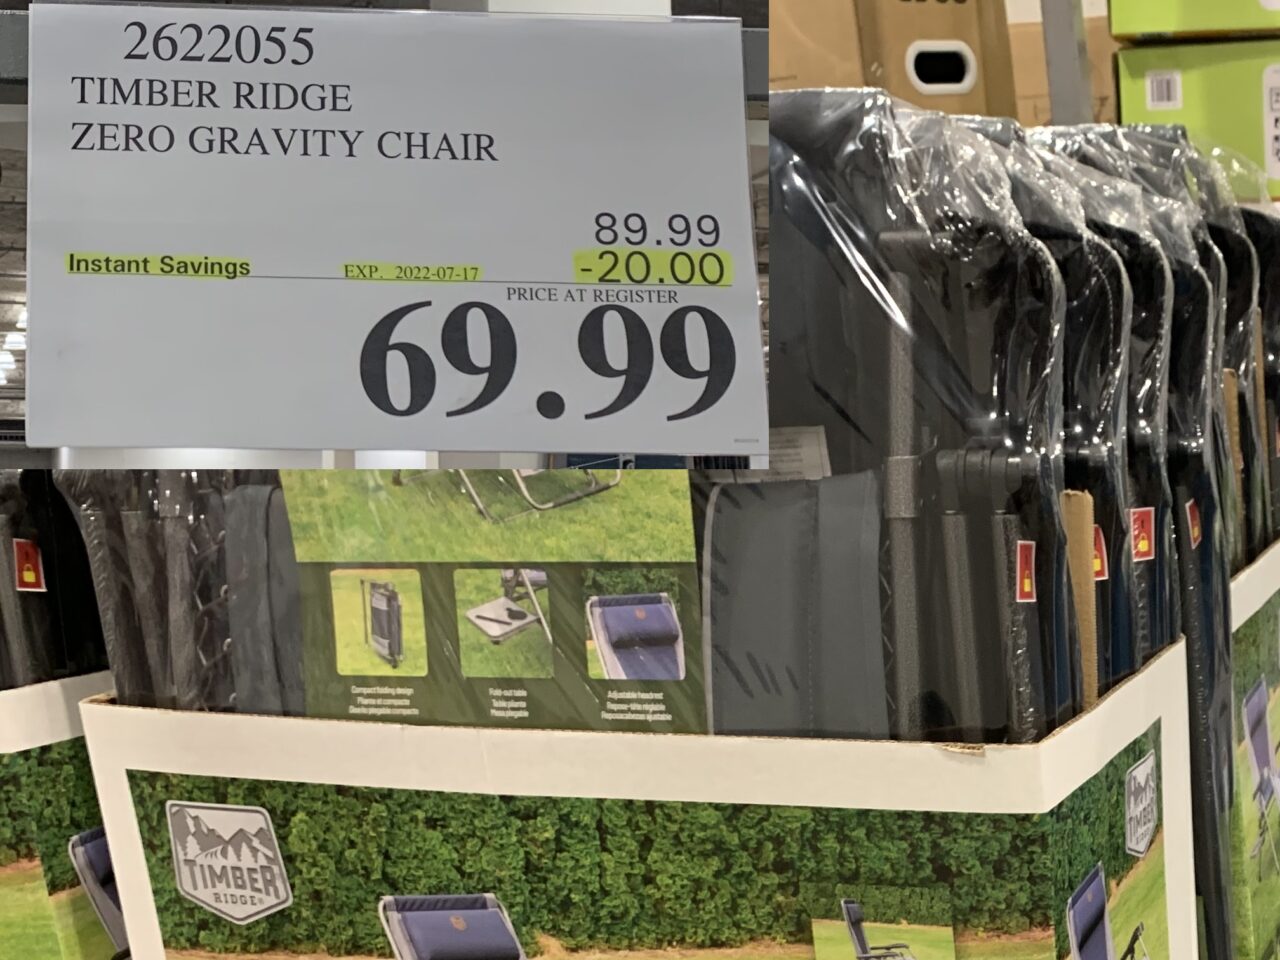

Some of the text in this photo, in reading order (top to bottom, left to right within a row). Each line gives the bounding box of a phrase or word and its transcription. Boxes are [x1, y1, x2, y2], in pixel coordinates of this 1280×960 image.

[123, 21, 314, 66] 2622055
[71, 76, 353, 112] TIMBER RIDGE
[71, 122, 499, 162] ZERO GRAVITY CHAIR
[594, 212, 720, 248] 89.99
[69, 253, 250, 279] Instant Savings
[344, 264, 479, 281] EXP. 2022-07-17
[580, 250, 724, 284] -20.00
[506, 287, 678, 304] PRICE AT REGISTER
[359, 300, 737, 422] 69.99
[183, 859, 280, 900] TIMBER
